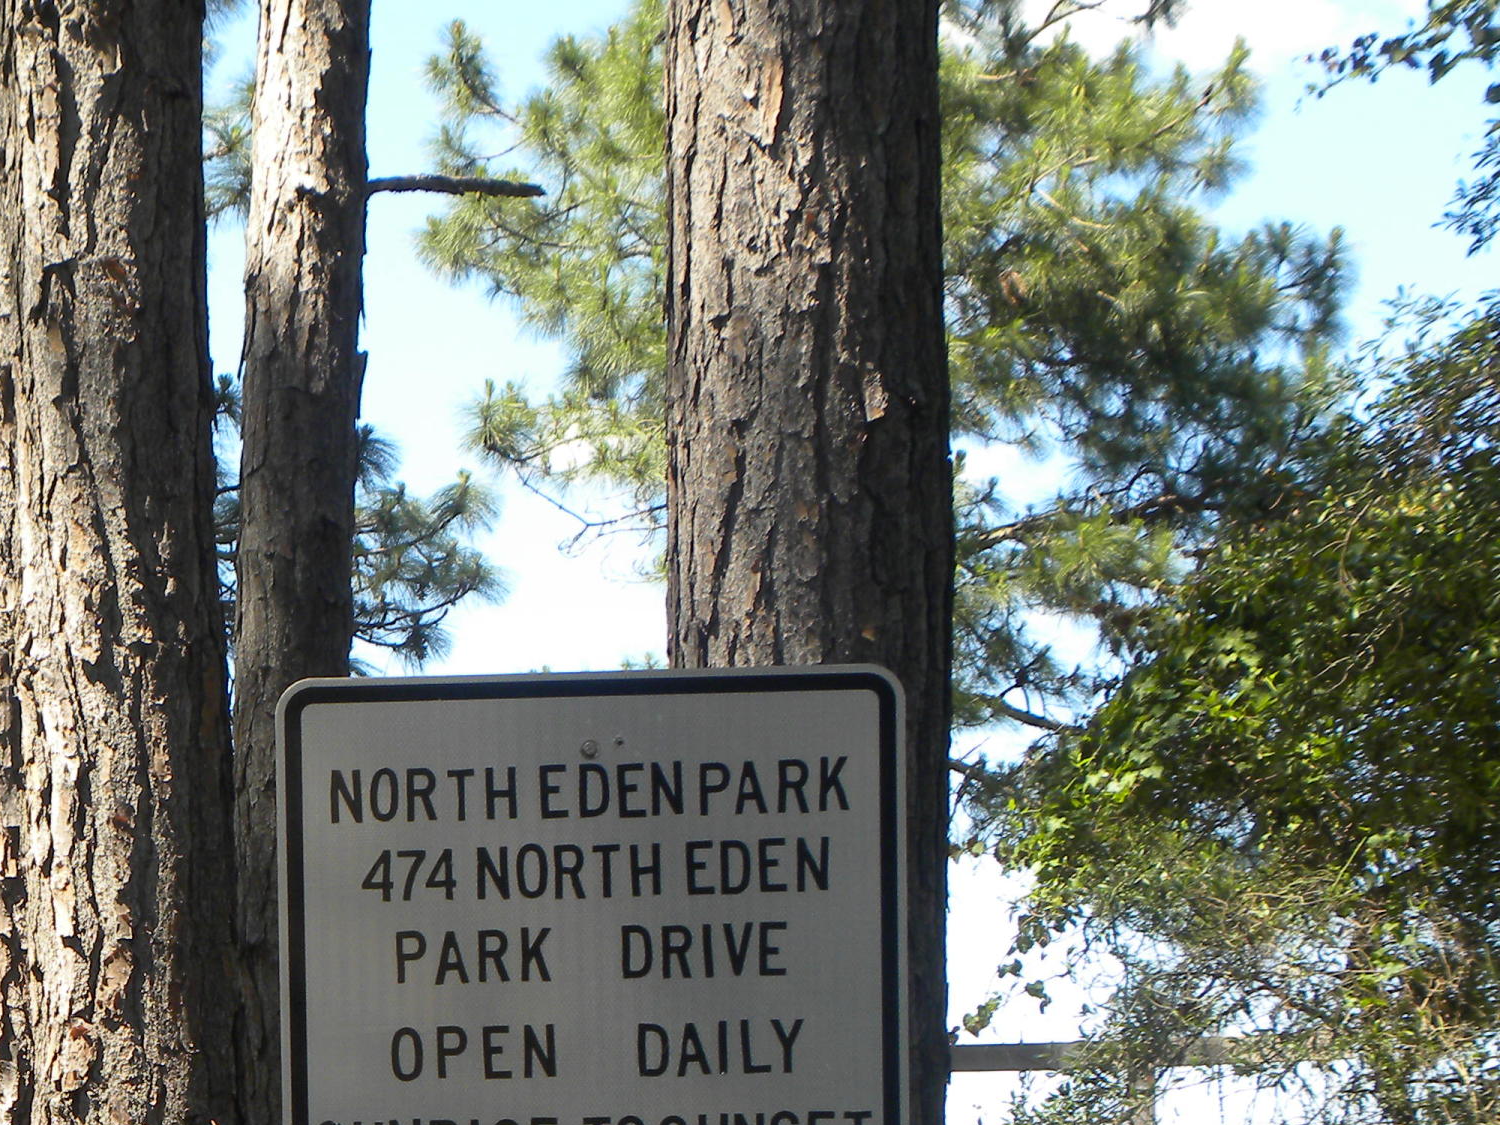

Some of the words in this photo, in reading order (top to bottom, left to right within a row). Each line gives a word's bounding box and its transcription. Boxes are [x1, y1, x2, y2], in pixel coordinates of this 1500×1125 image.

[330, 766, 518, 825] NORTH
[537, 761, 685, 820] EDEN
[697, 755, 851, 816] PARK
[360, 847, 457, 903] 474
[475, 842, 663, 901] NORTH
[684, 836, 831, 896] EDEN
[394, 926, 552, 985] PARK
[620, 921, 788, 980] DRIVE
[389, 1023, 557, 1082] OPEN
[636, 1018, 805, 1078] DAILY
